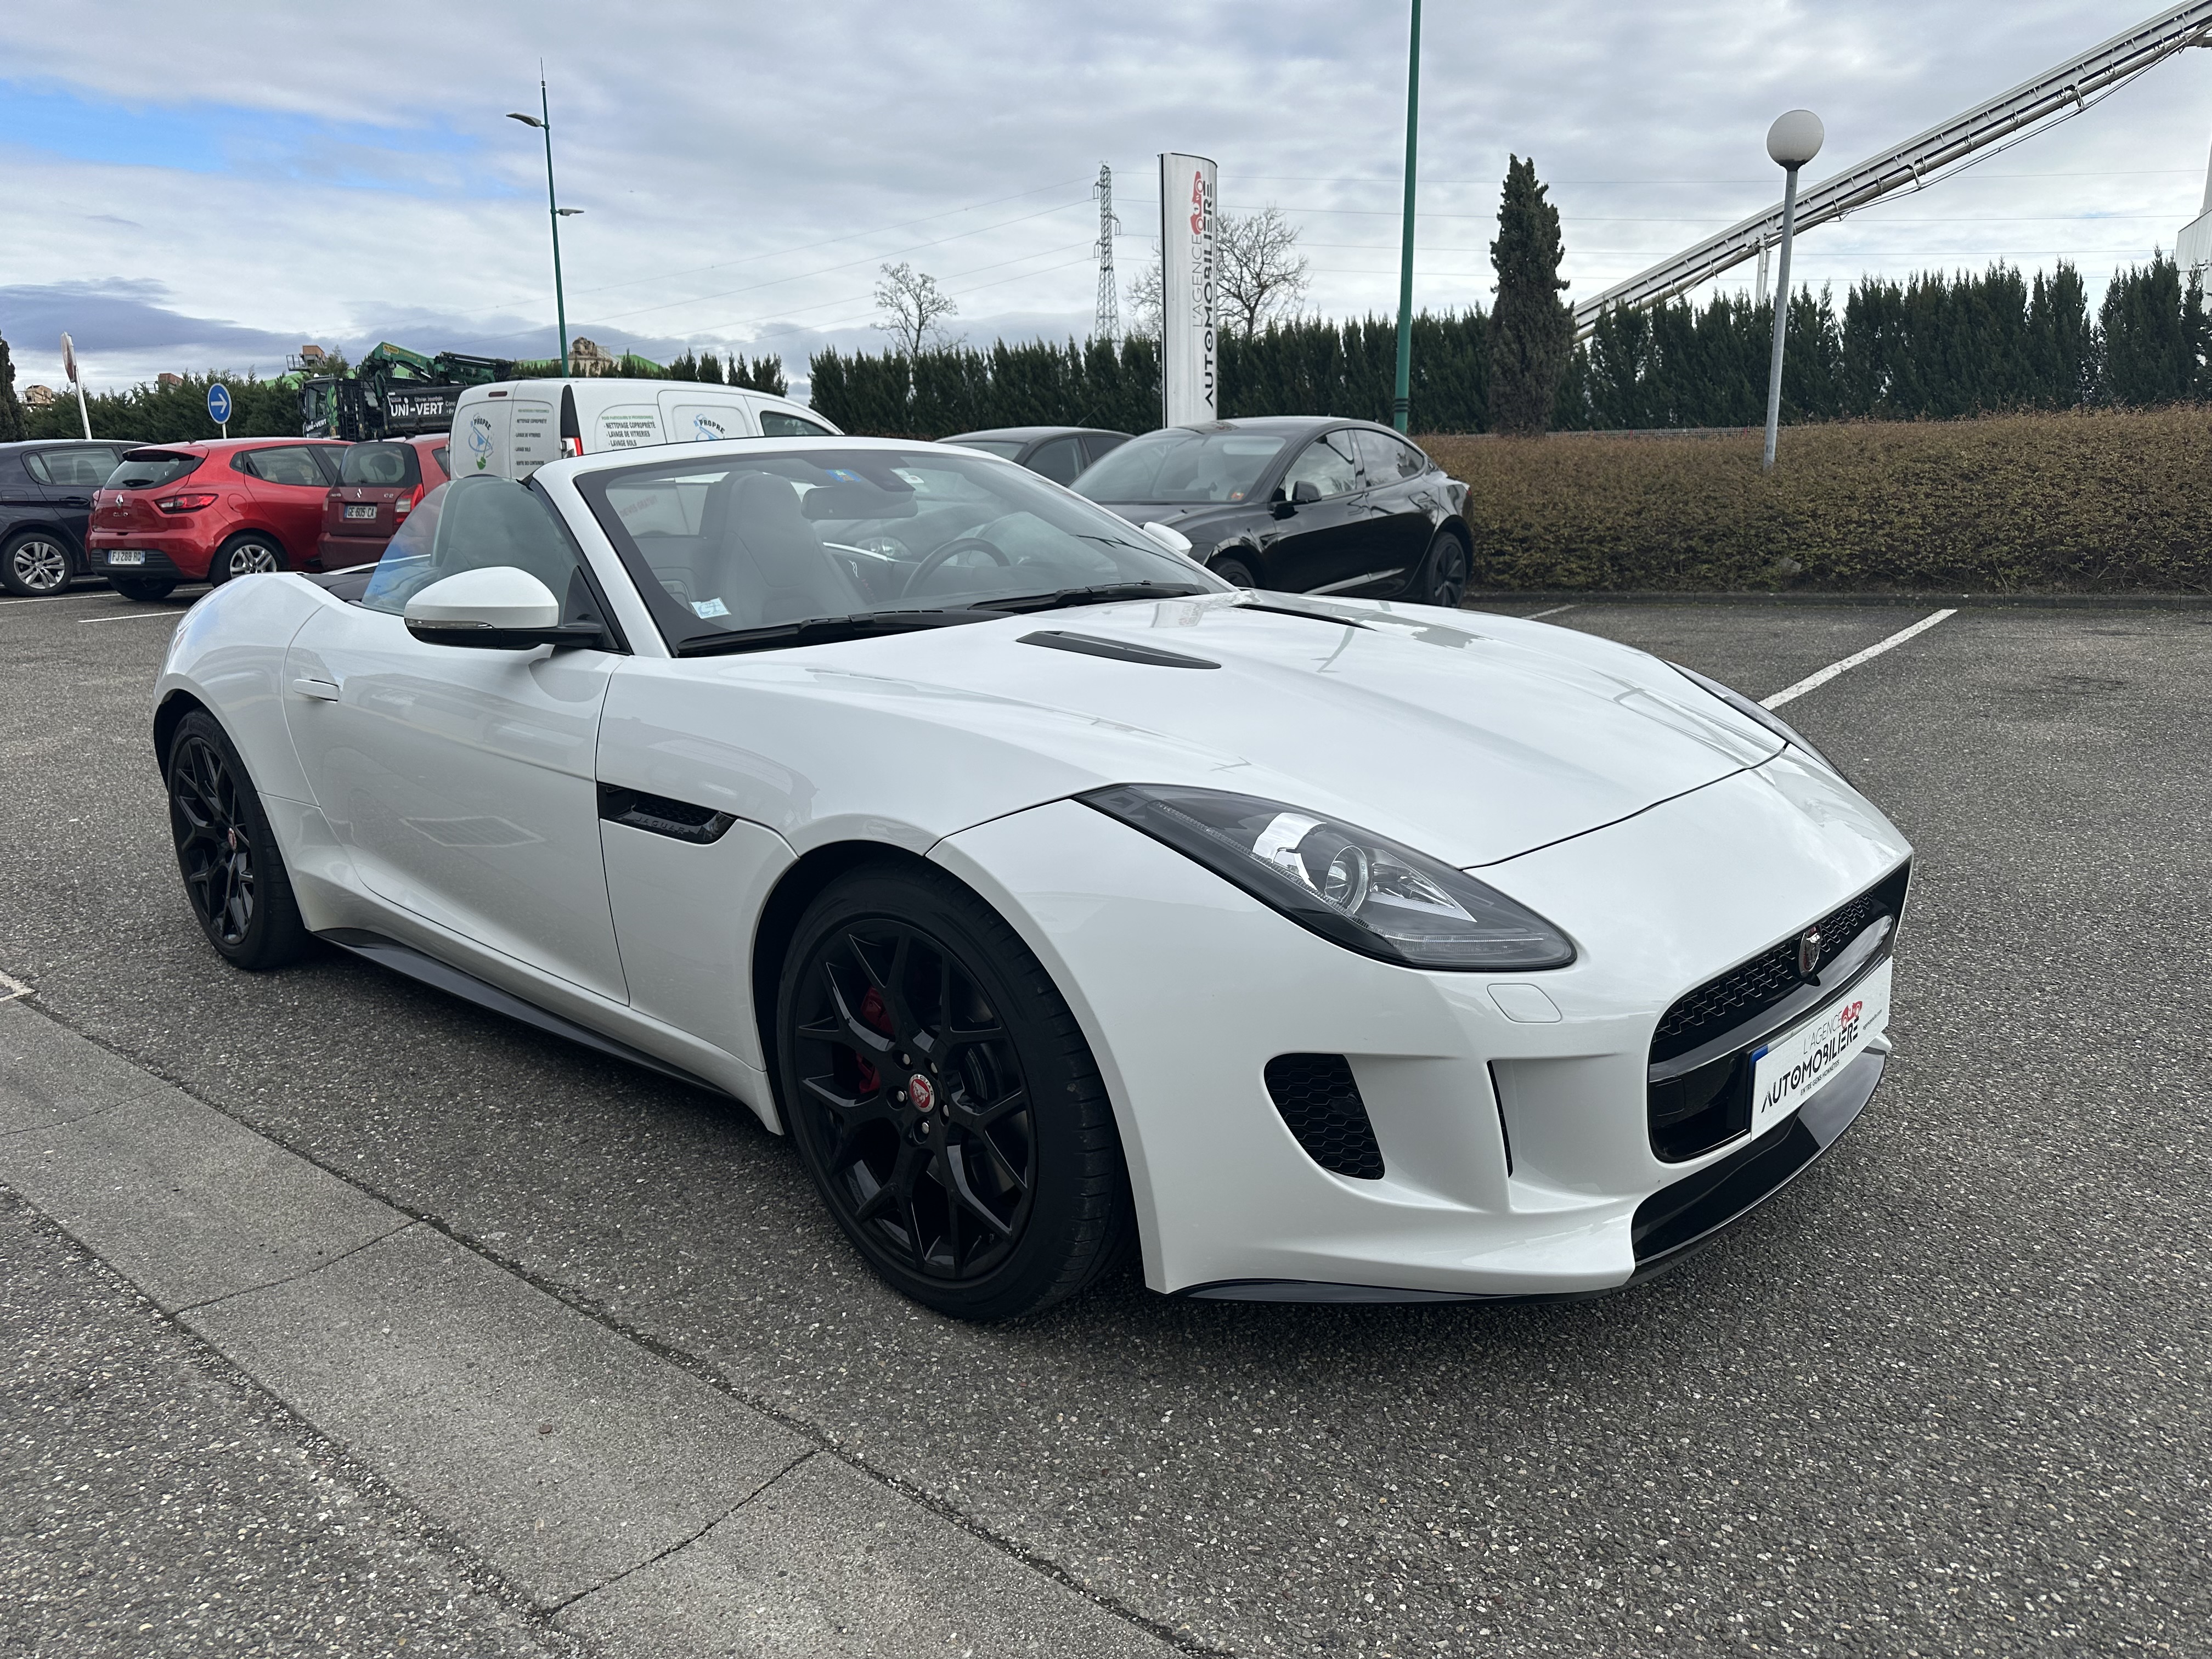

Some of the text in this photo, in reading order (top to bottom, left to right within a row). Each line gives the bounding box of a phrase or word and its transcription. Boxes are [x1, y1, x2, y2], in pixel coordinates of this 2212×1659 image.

[1191, 234, 1203, 328] L'AGENCE
[699, 419, 725, 435] PROPRE
[635, 817, 685, 834] JAGUAR
[1803, 1010, 1842, 1055] L'AGENCE
[1800, 1081, 1812, 1096] ENTRE
